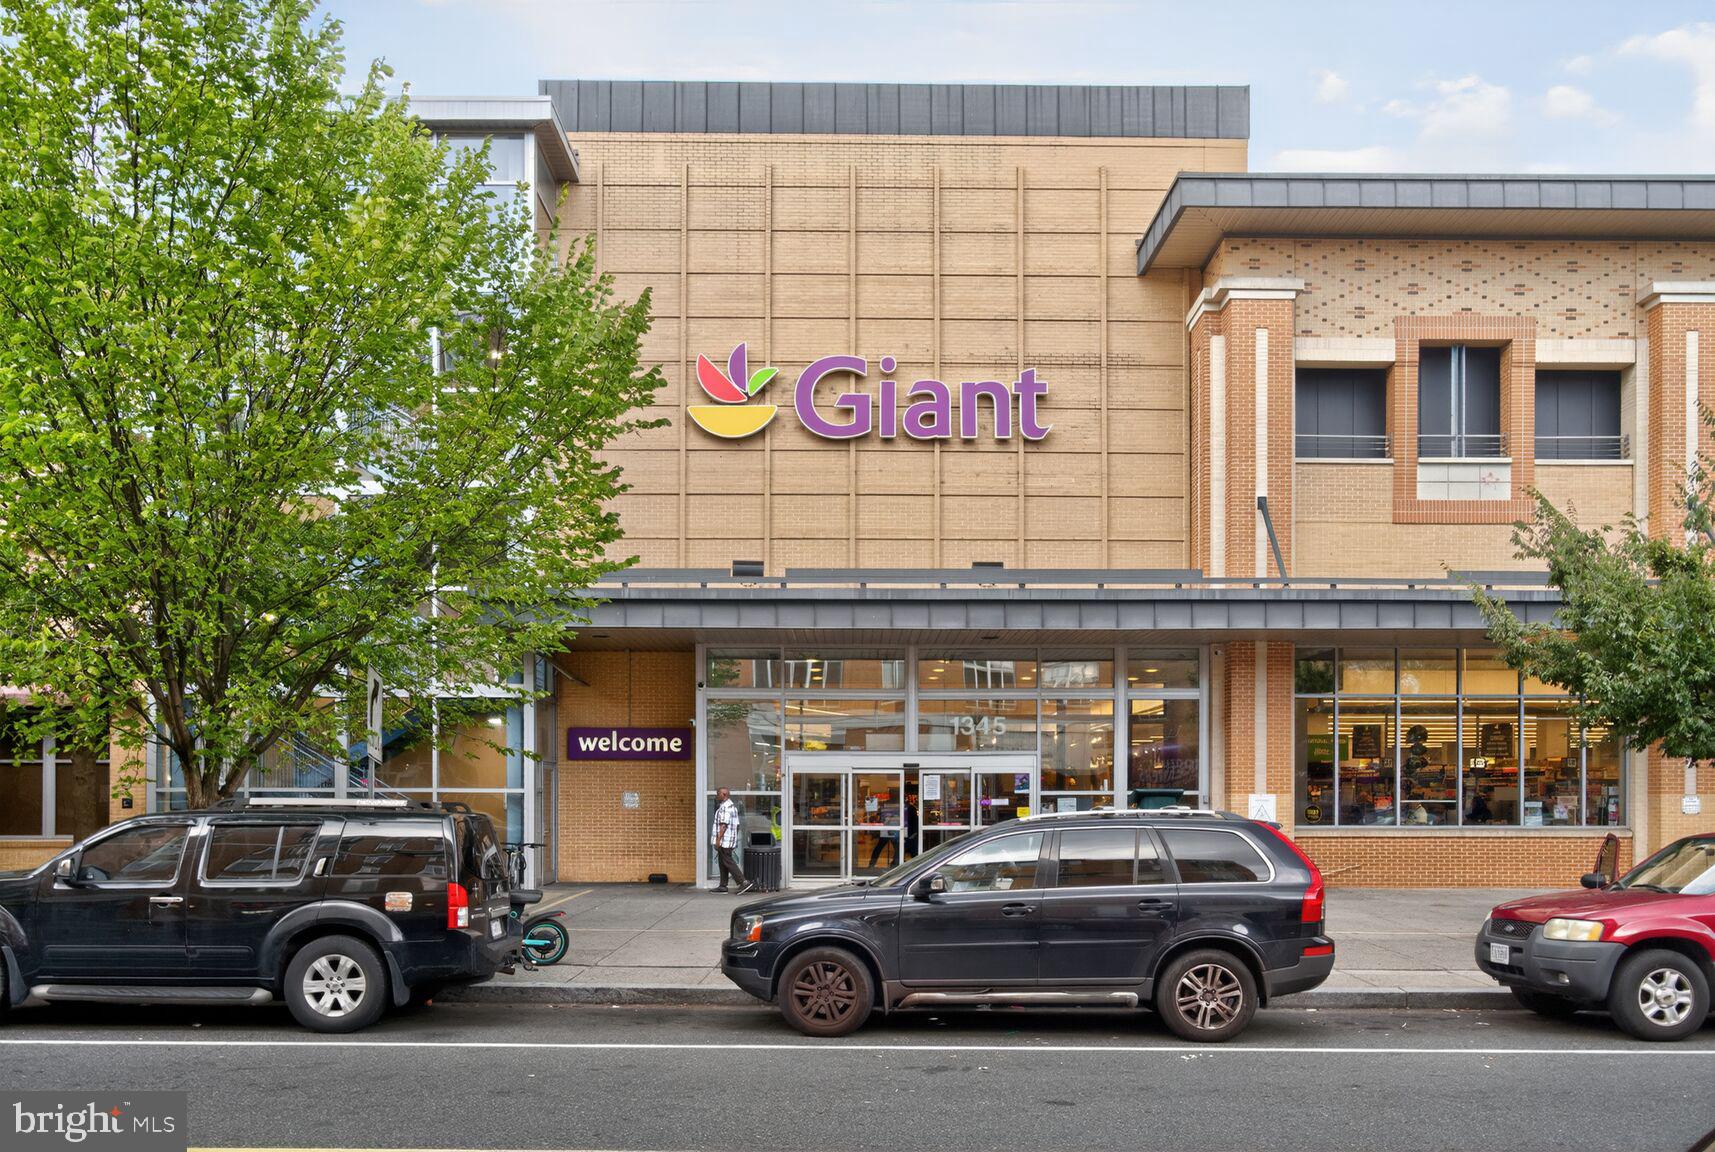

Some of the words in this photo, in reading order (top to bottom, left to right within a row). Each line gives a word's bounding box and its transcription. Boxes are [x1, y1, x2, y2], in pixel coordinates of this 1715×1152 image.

[794, 354, 1053, 440] Giant
[950, 716, 1006, 736] 1345
[578, 731, 682, 753] welcome
